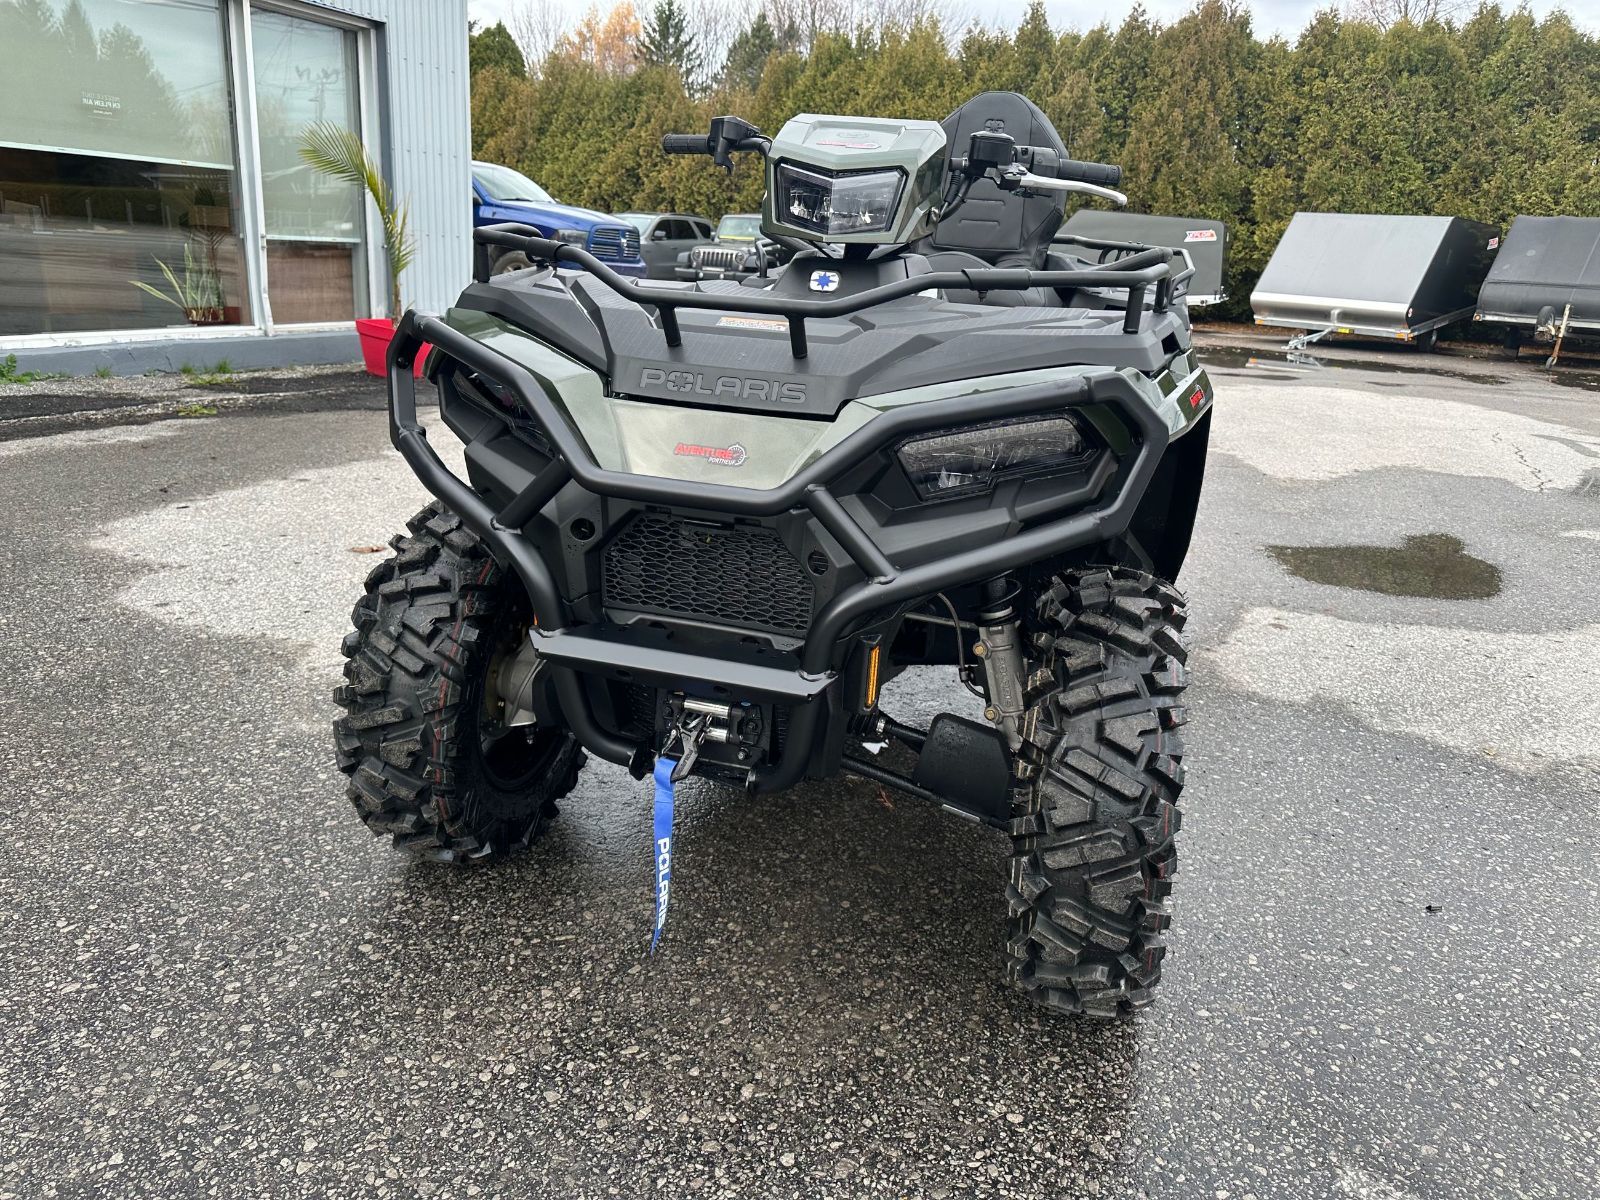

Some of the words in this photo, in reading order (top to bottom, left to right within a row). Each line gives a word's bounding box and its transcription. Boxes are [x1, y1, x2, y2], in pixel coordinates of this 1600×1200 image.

[640, 367, 807, 404] POLARIS
[674, 442, 733, 459] AVENTURE
[658, 837, 670, 930] POLARIS
